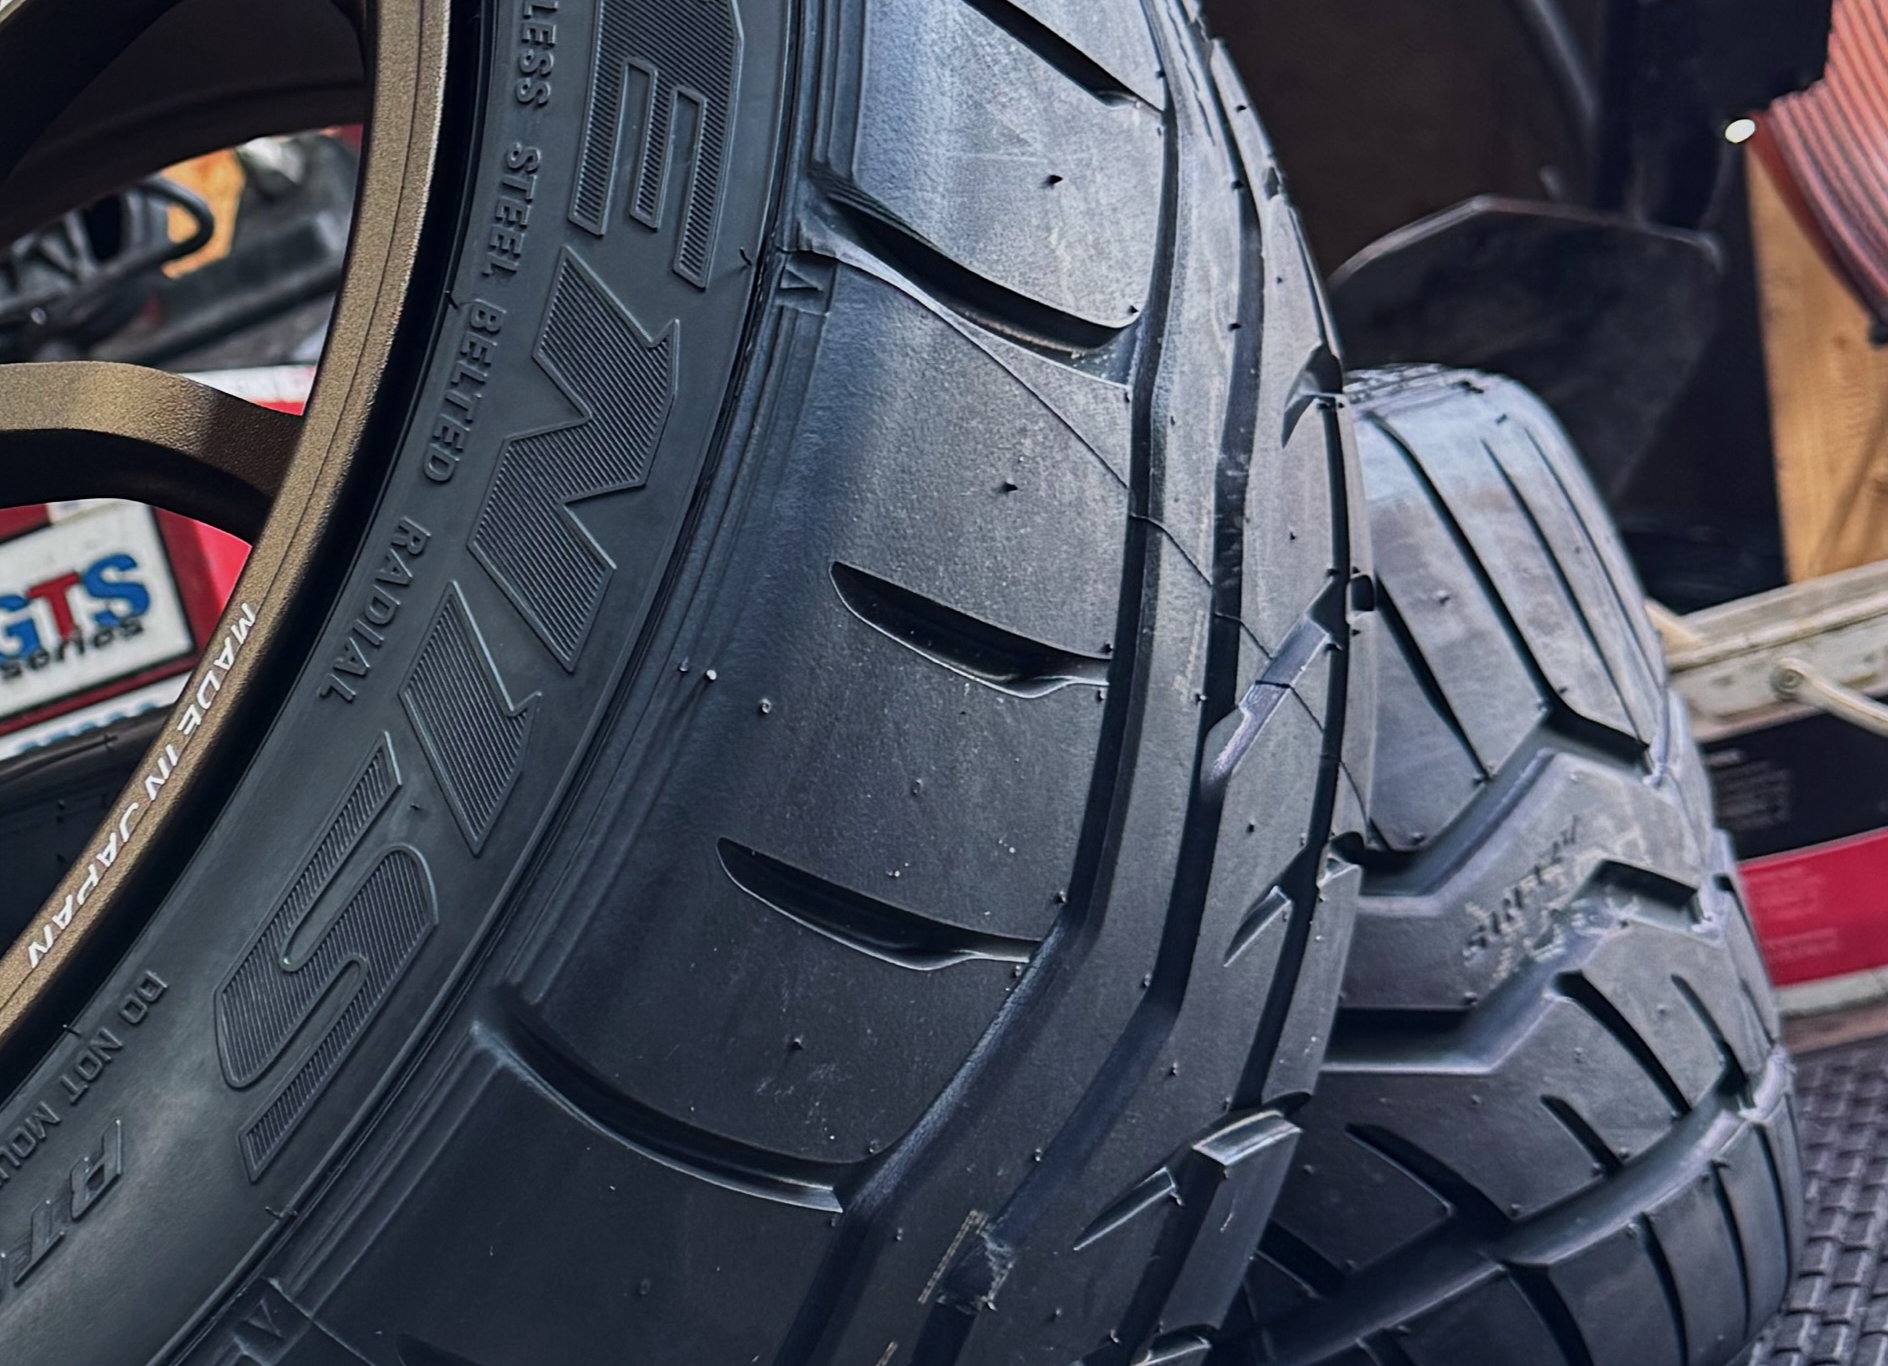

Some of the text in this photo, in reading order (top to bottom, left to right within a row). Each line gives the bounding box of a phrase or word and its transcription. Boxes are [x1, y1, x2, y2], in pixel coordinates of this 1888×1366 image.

[479, 141, 542, 278] STEEL
[423, 298, 508, 486] BELTED
[318, 515, 433, 704] RADIAL
[27, 602, 257, 969] MADE IN JAPAN
[65, 1026, 124, 1106] NOT
[118, 969, 169, 1025] DO
